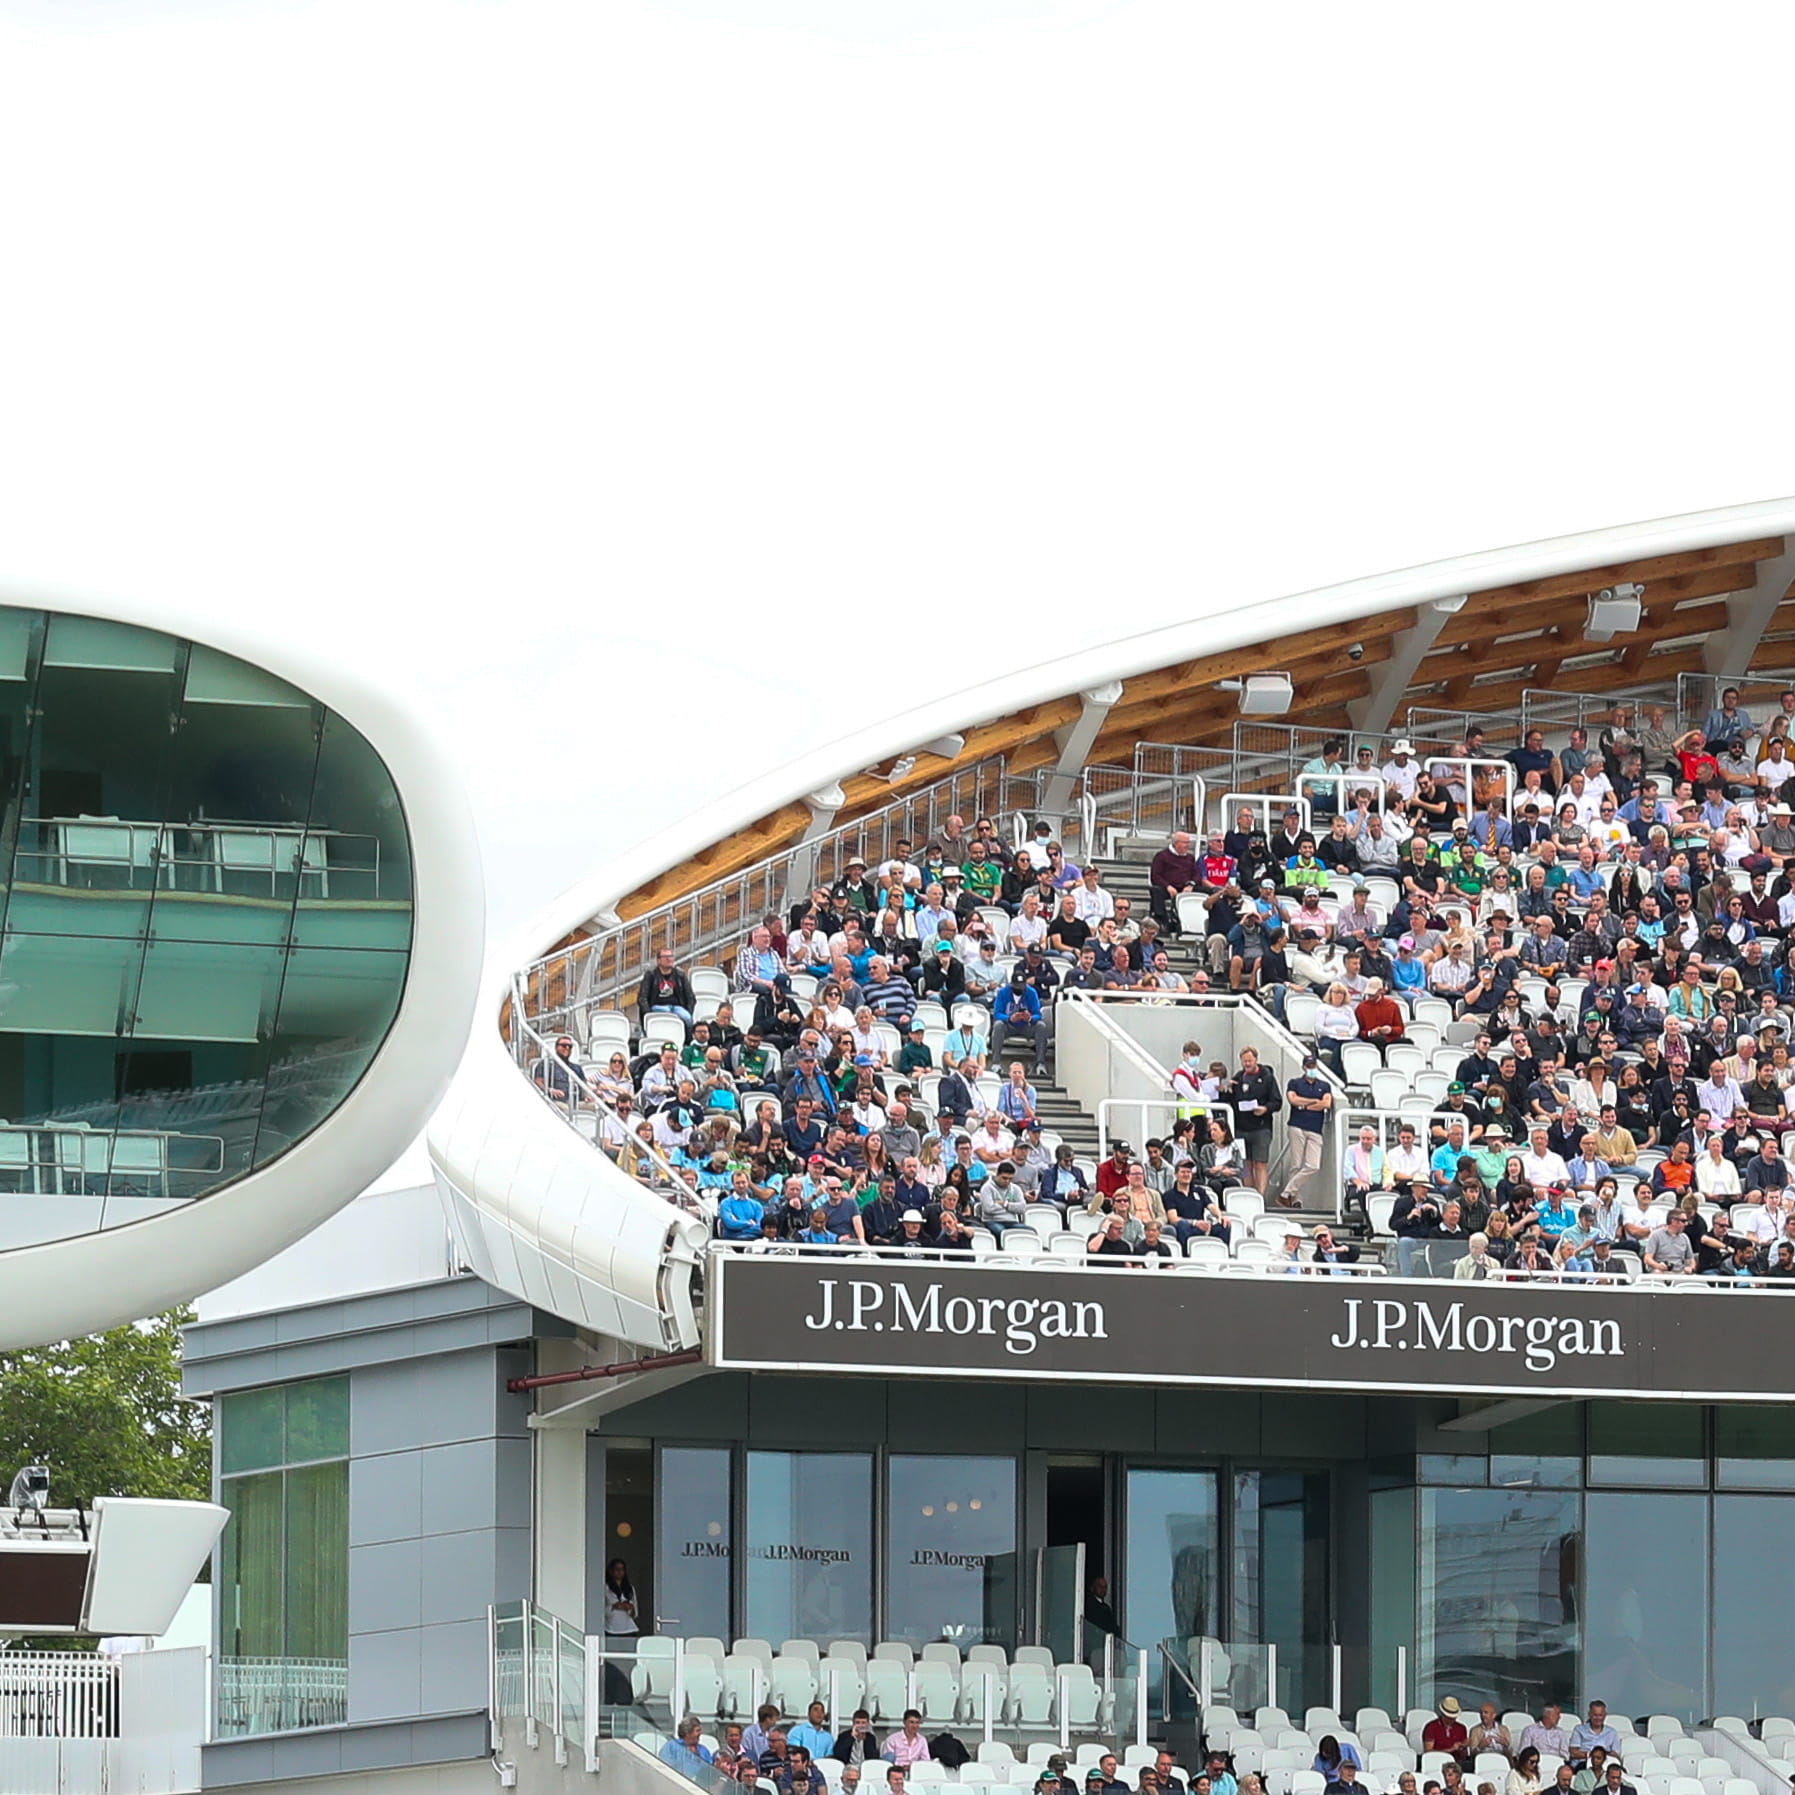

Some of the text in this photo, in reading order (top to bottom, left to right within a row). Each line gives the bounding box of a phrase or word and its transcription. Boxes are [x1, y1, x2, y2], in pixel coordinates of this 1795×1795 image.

[806, 1280, 1107, 1354] J.P.Morgan
[1332, 1300, 1624, 1371] J.P.Morgan
[681, 1542, 730, 1558] J.P.Mo
[765, 1545, 850, 1566] J.P.Morgan
[910, 1550, 986, 1571] J.P.Morga
